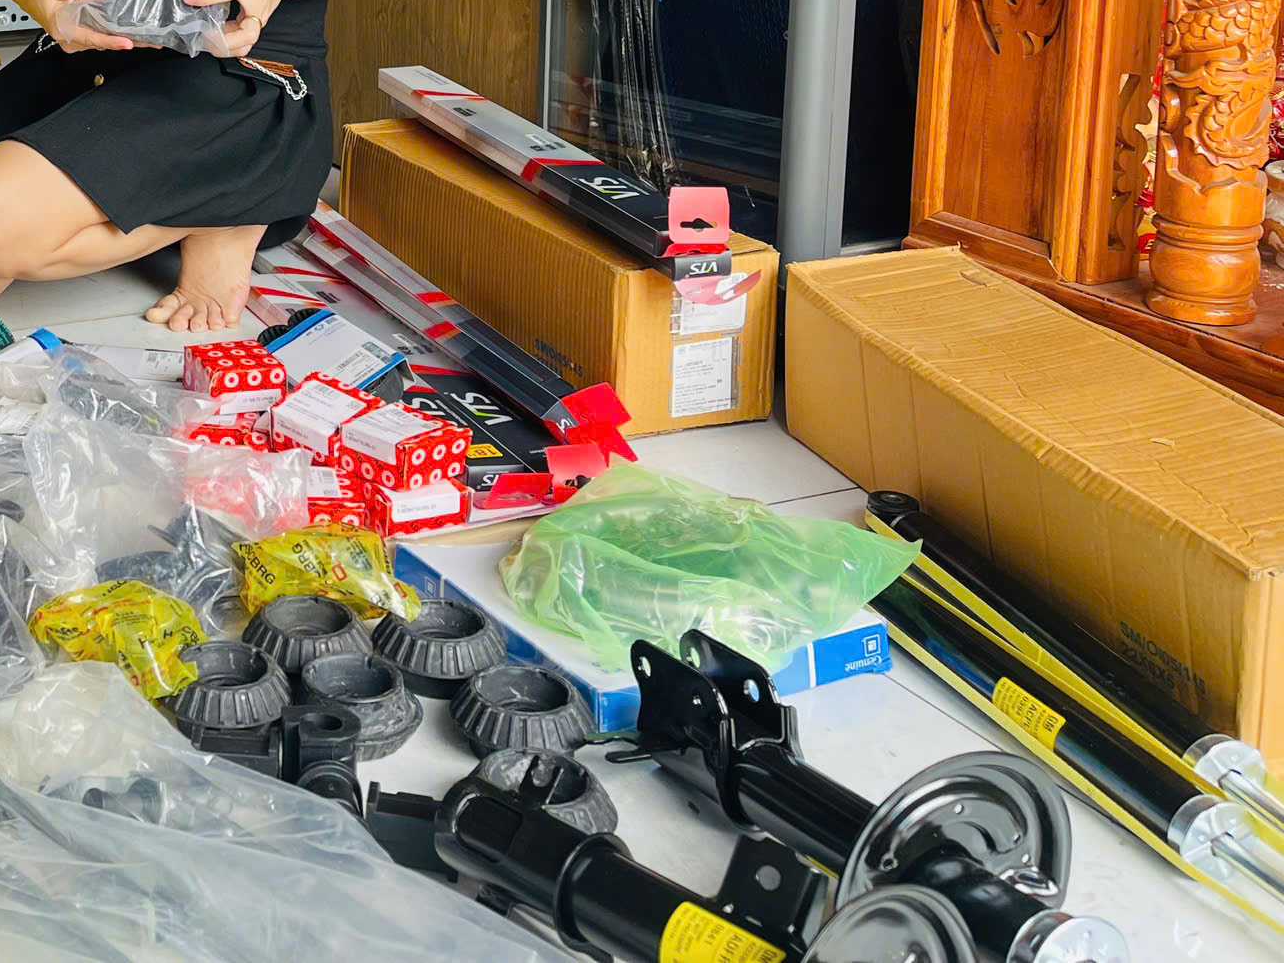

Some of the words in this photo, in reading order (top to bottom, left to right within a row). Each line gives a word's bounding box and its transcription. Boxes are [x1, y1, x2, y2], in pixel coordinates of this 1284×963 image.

[688, 260, 718, 276] VTS
[449, 392, 514, 426] VTS
[844, 654, 883, 672] Genuine
